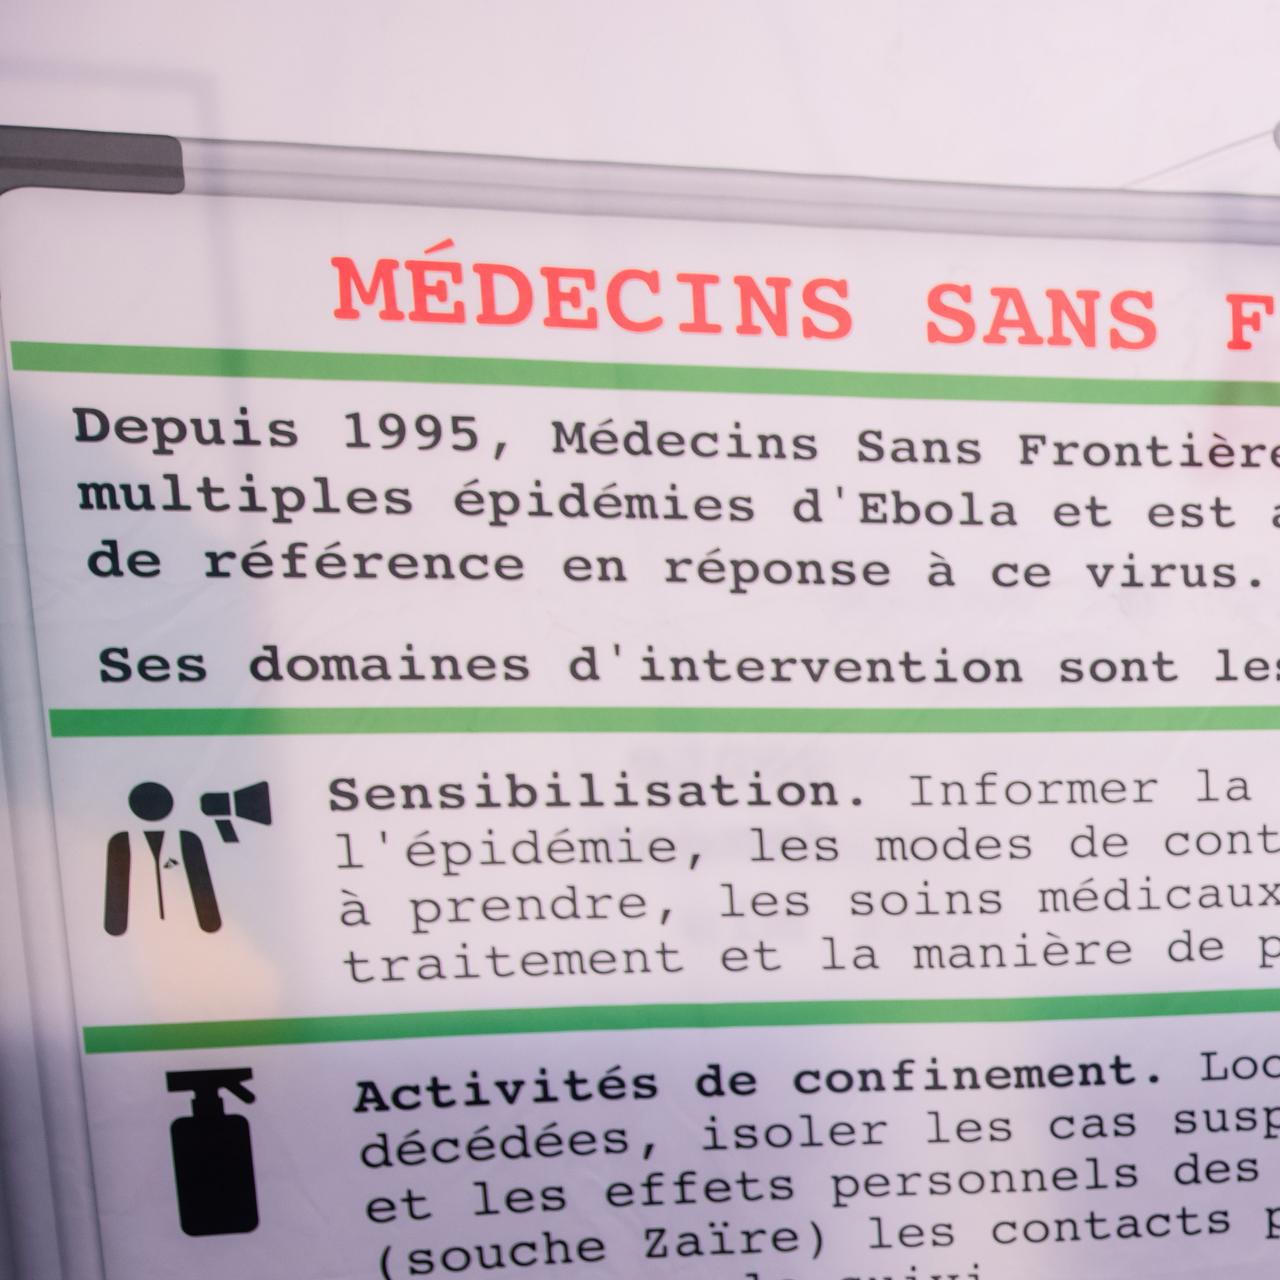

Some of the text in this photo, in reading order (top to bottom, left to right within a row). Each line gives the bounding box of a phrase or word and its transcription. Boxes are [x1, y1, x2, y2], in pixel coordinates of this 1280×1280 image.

[330, 238, 852, 340] MÉDECINS
[927, 283, 1157, 350] SANS
[72, 407, 297, 455] Depuis
[345, 412, 506, 460] 1995,
[552, 419, 817, 460] Médecins
[858, 430, 981, 464] Sans
[77, 473, 412, 524] multiples
[455, 479, 754, 527] épidémies
[793, 486, 1017, 526] d'Ebola
[1054, 496, 1111, 527] et
[1148, 497, 1235, 528] est
[88, 539, 1260, 594] de référence en réponse à ce virus.
[99, 647, 206, 683] Ses
[250, 644, 529, 682] domaines
[570, 644, 1023, 683] d'intervention
[1060, 651, 1178, 683] sont
[330, 771, 861, 811] Sensibilisation.
[910, 772, 1157, 805] Informer
[1198, 769, 1251, 801] la
[337, 827, 700, 876] l'épidémie,
[751, 828, 838, 861] les
[876, 827, 1031, 861] modes
[1071, 825, 1128, 858] de
[341, 890, 370, 926] à
[410, 886, 670, 934] prendre,
[721, 884, 808, 916] les
[851, 881, 1001, 915] soins
[344, 943, 683, 983] traitement
[722, 941, 781, 971] et
[823, 937, 879, 969] la
[913, 932, 1131, 968] manière
[1168, 930, 1223, 962] de
[353, 1065, 658, 1113] Activités
[696, 1064, 756, 1098] de
[793, 1055, 1158, 1094] confinement.
[360, 1122, 654, 1169] décédées,
[703, 1115, 887, 1150] isoler
[928, 1111, 1011, 1143] les
[1050, 1113, 1136, 1139] cas
[366, 1153, 1258, 1223] et les effets personnels des
[645, 1221, 822, 1259] Zaïre)
[870, 1217, 954, 1248] les
[993, 1207, 1230, 1244] contacts
